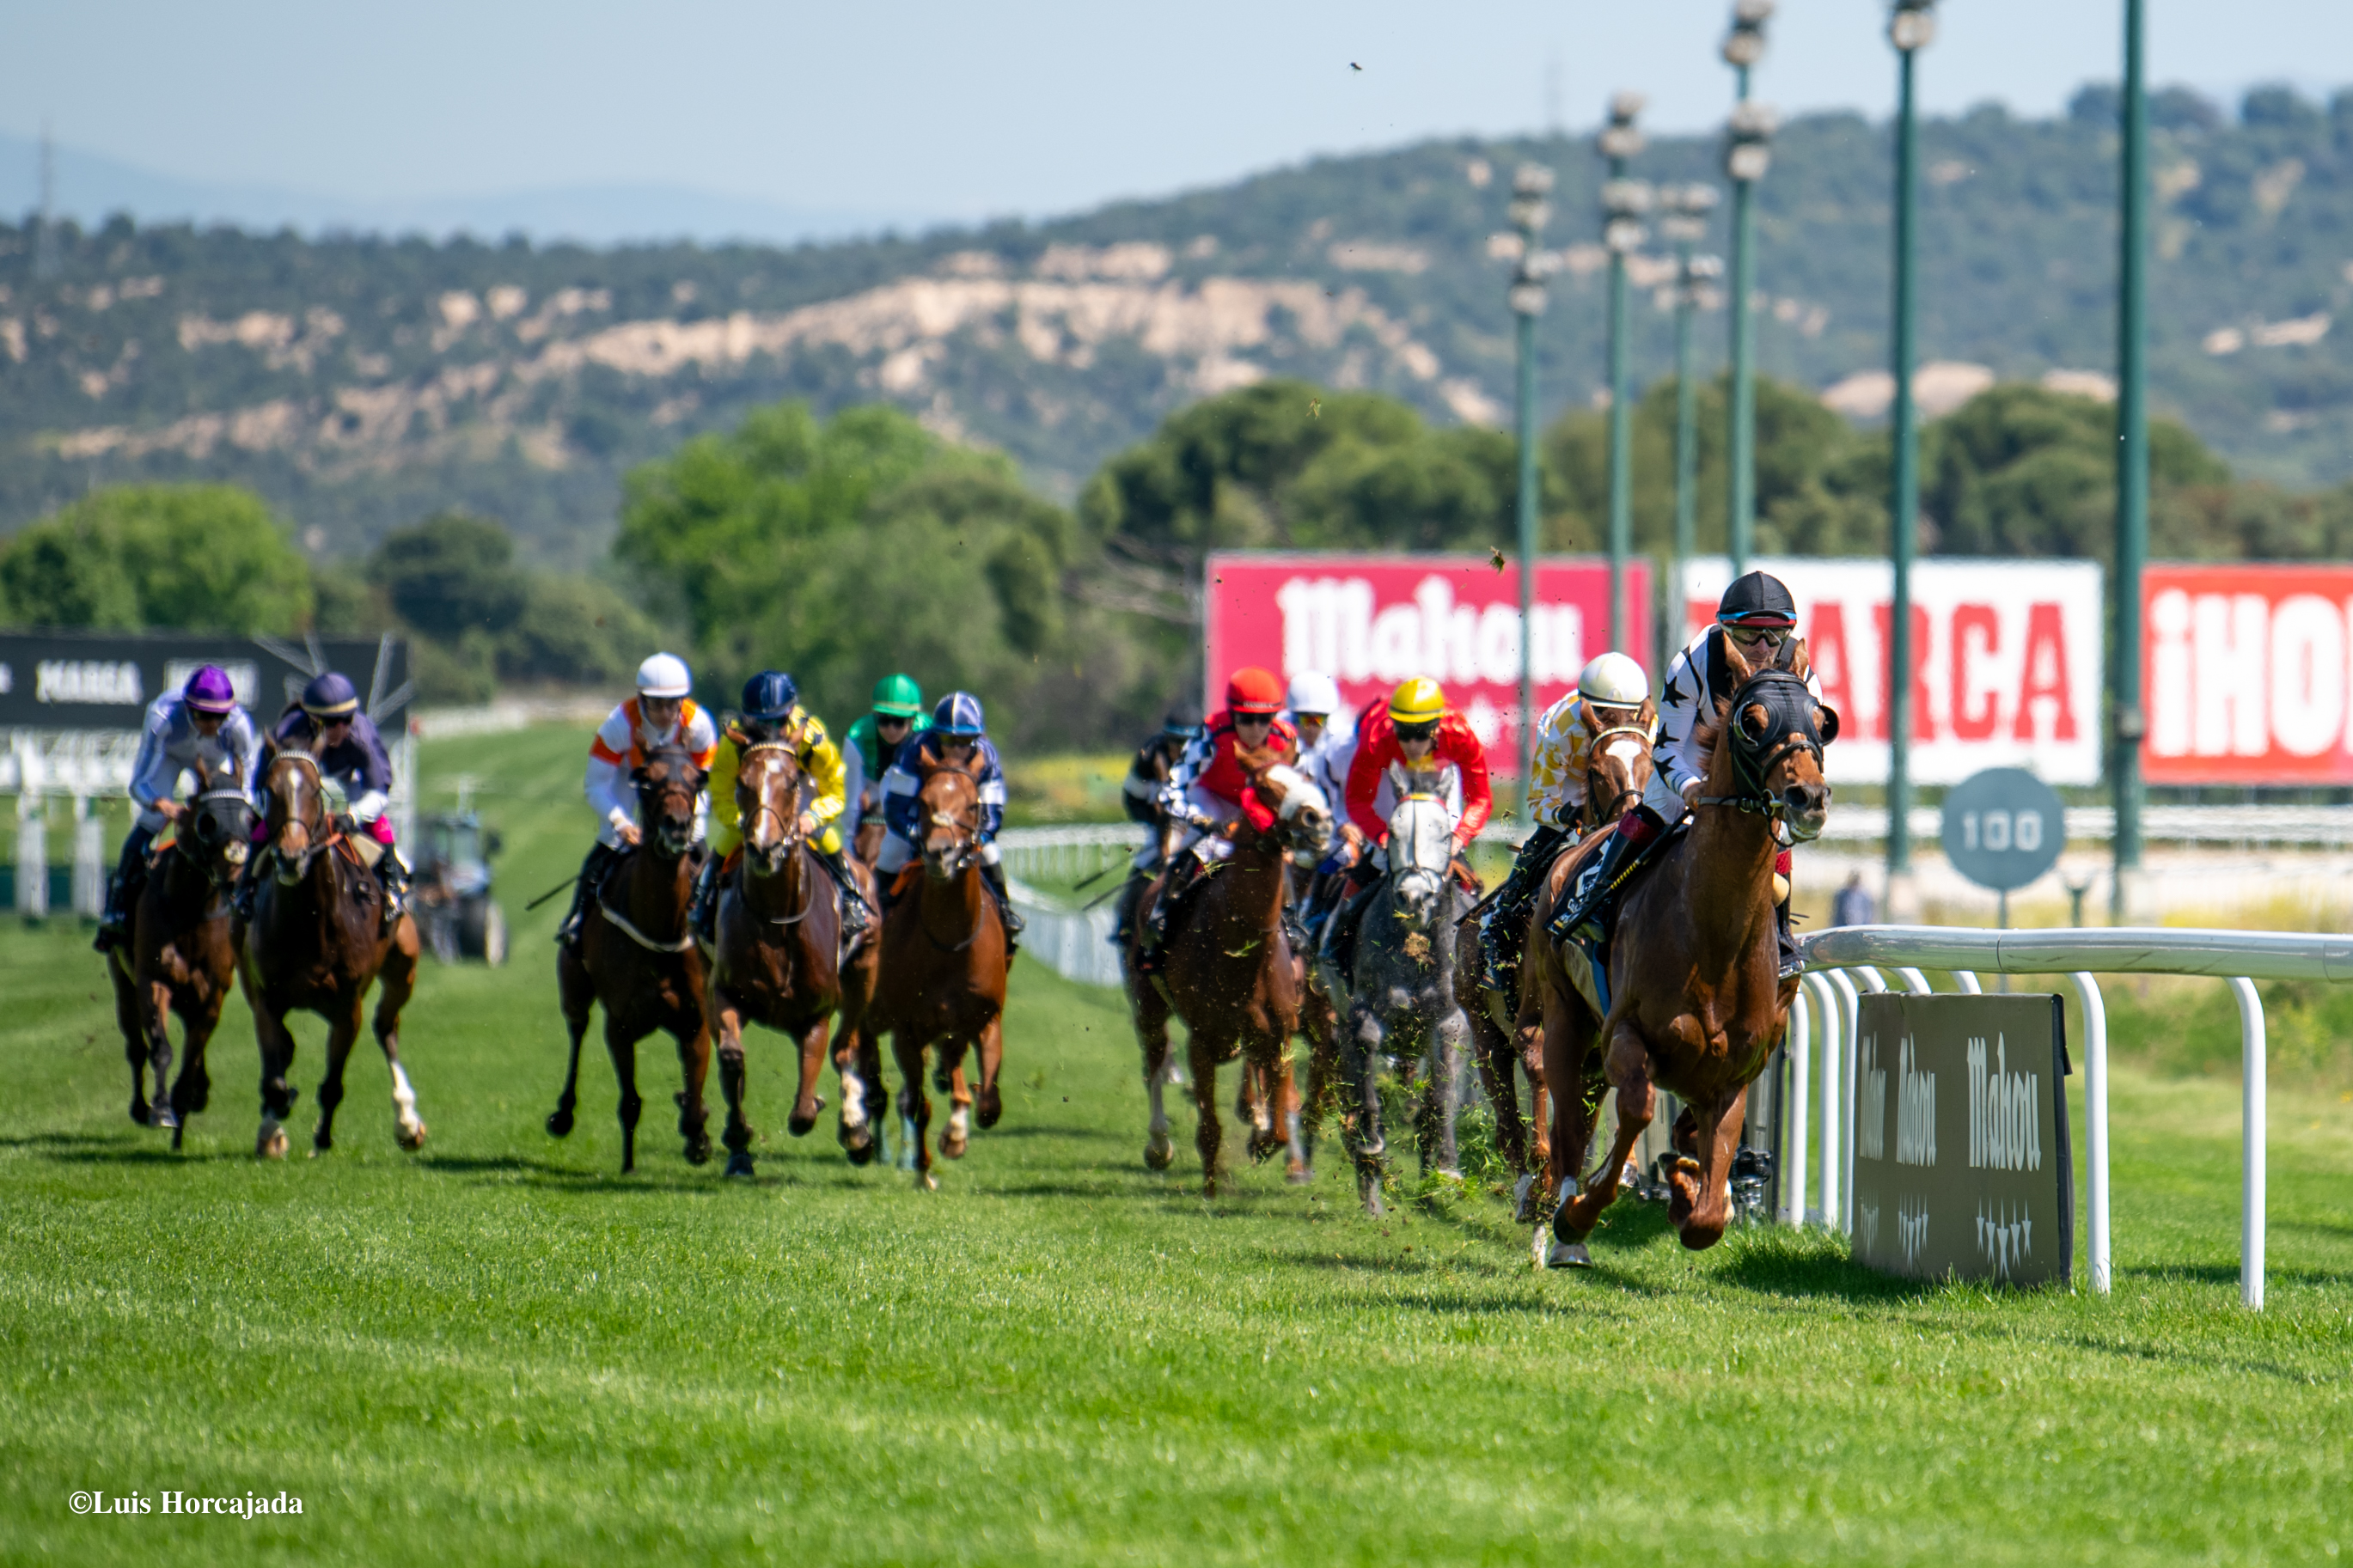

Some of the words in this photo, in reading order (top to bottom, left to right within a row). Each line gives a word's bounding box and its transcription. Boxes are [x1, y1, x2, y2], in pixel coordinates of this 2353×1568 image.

[1277, 575, 1583, 685] Mahou
[1687, 601, 2077, 742] ARCA
[1964, 810, 2042, 851] 100
[1967, 1031, 2041, 1172] Mahou
